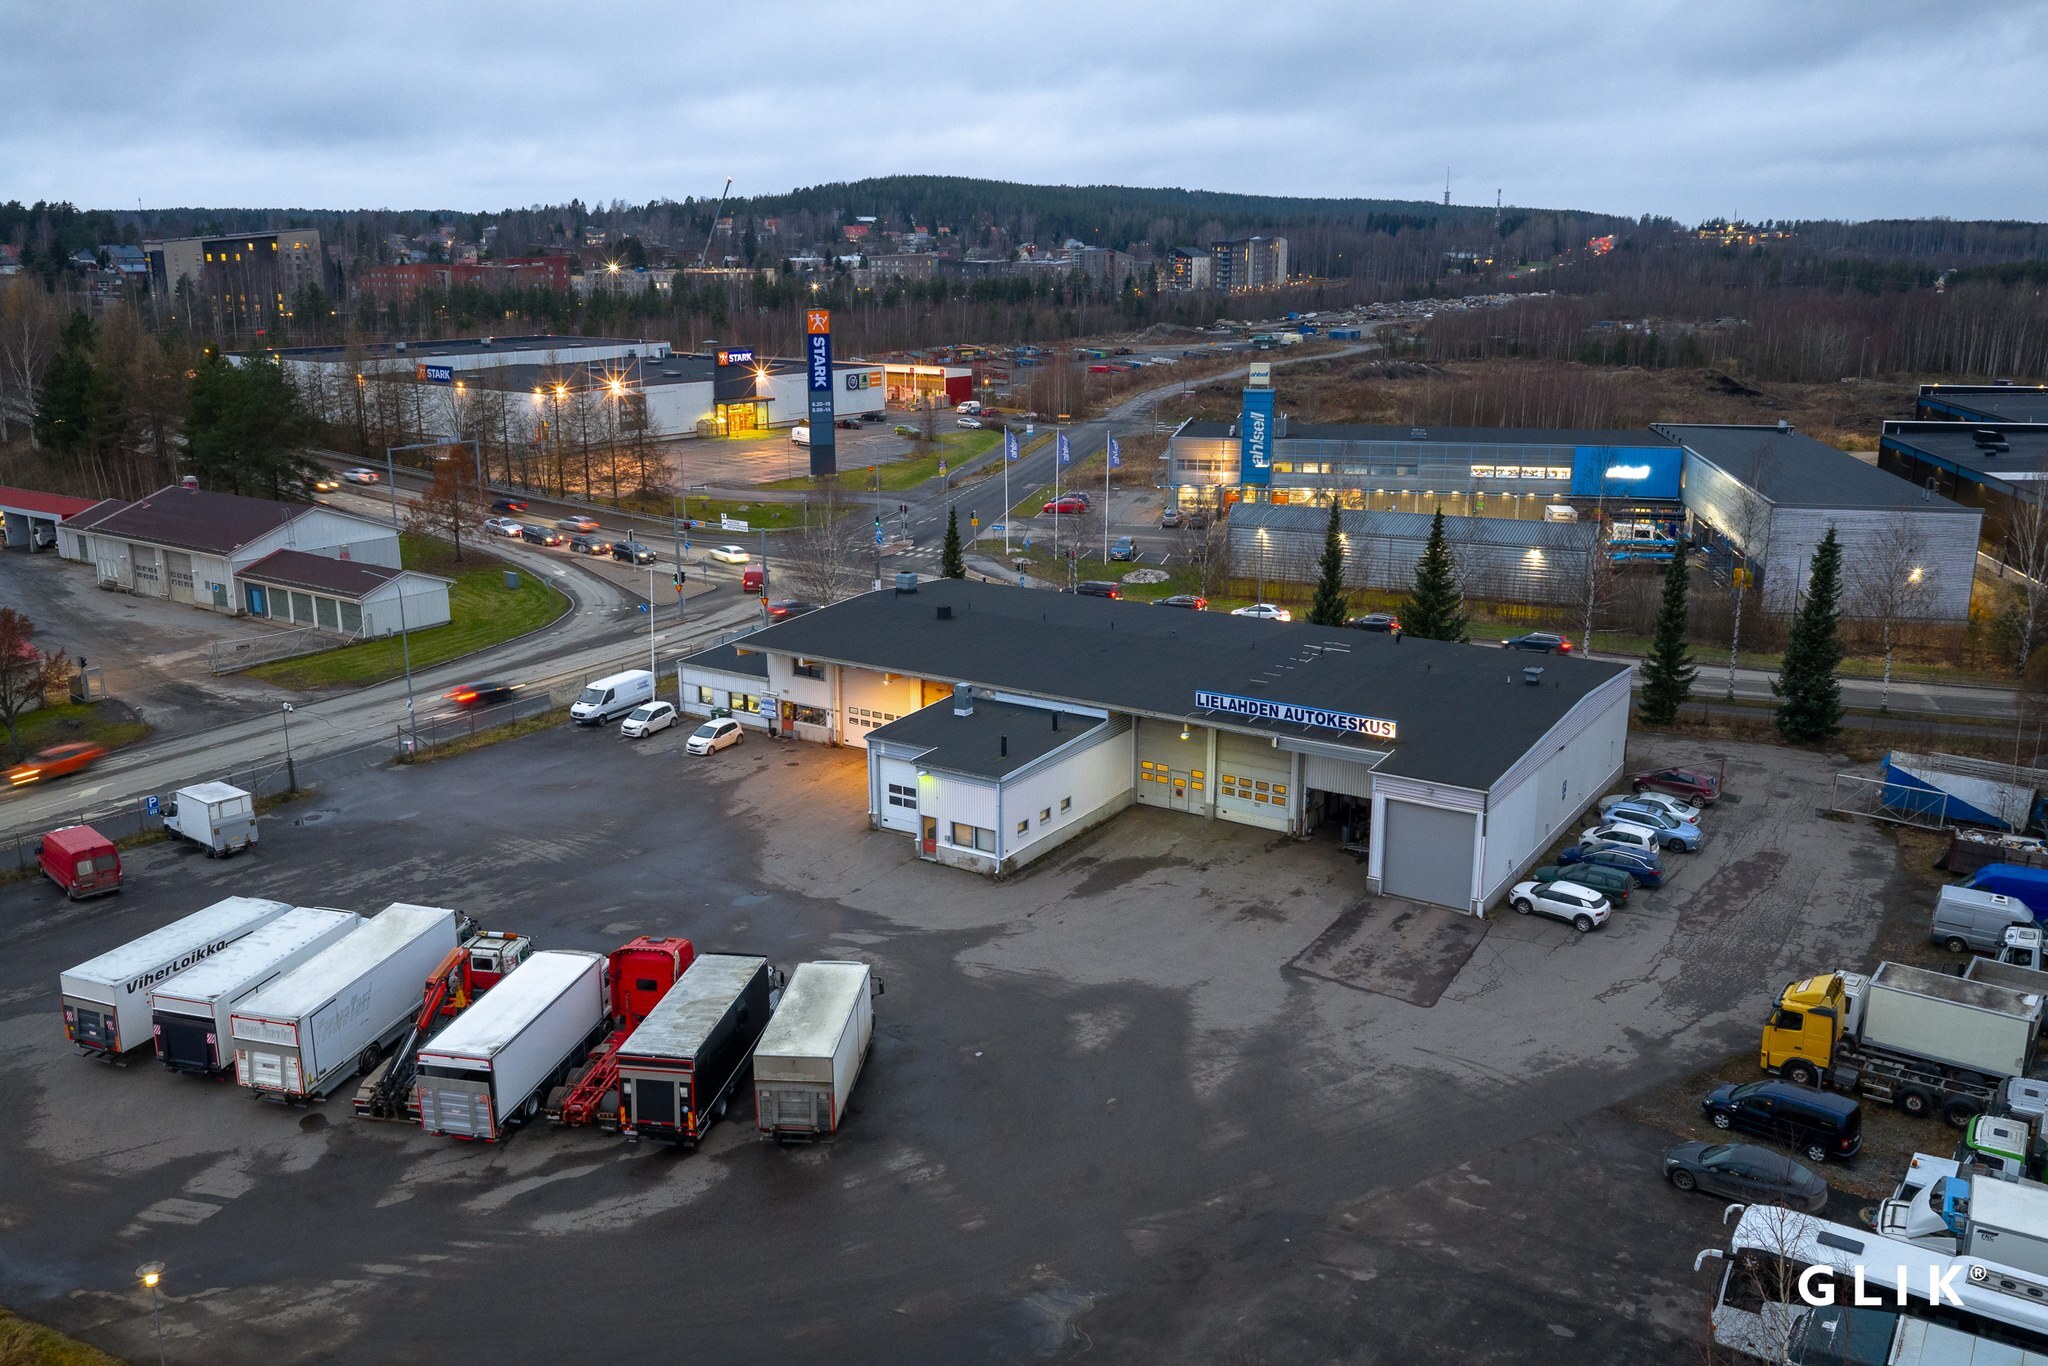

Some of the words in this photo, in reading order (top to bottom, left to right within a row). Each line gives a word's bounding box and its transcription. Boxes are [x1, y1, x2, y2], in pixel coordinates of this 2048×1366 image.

[426, 368, 450, 379] STARK
[728, 352, 752, 363] STARK
[813, 336, 827, 388] STARK
[1249, 411, 1266, 468] ahlsell
[1197, 693, 1279, 718] LIELAHDEN
[1284, 707, 1391, 736] AUTOKESKUS
[149, 797, 157, 808] P
[126, 940, 226, 995] ViherLoikka
